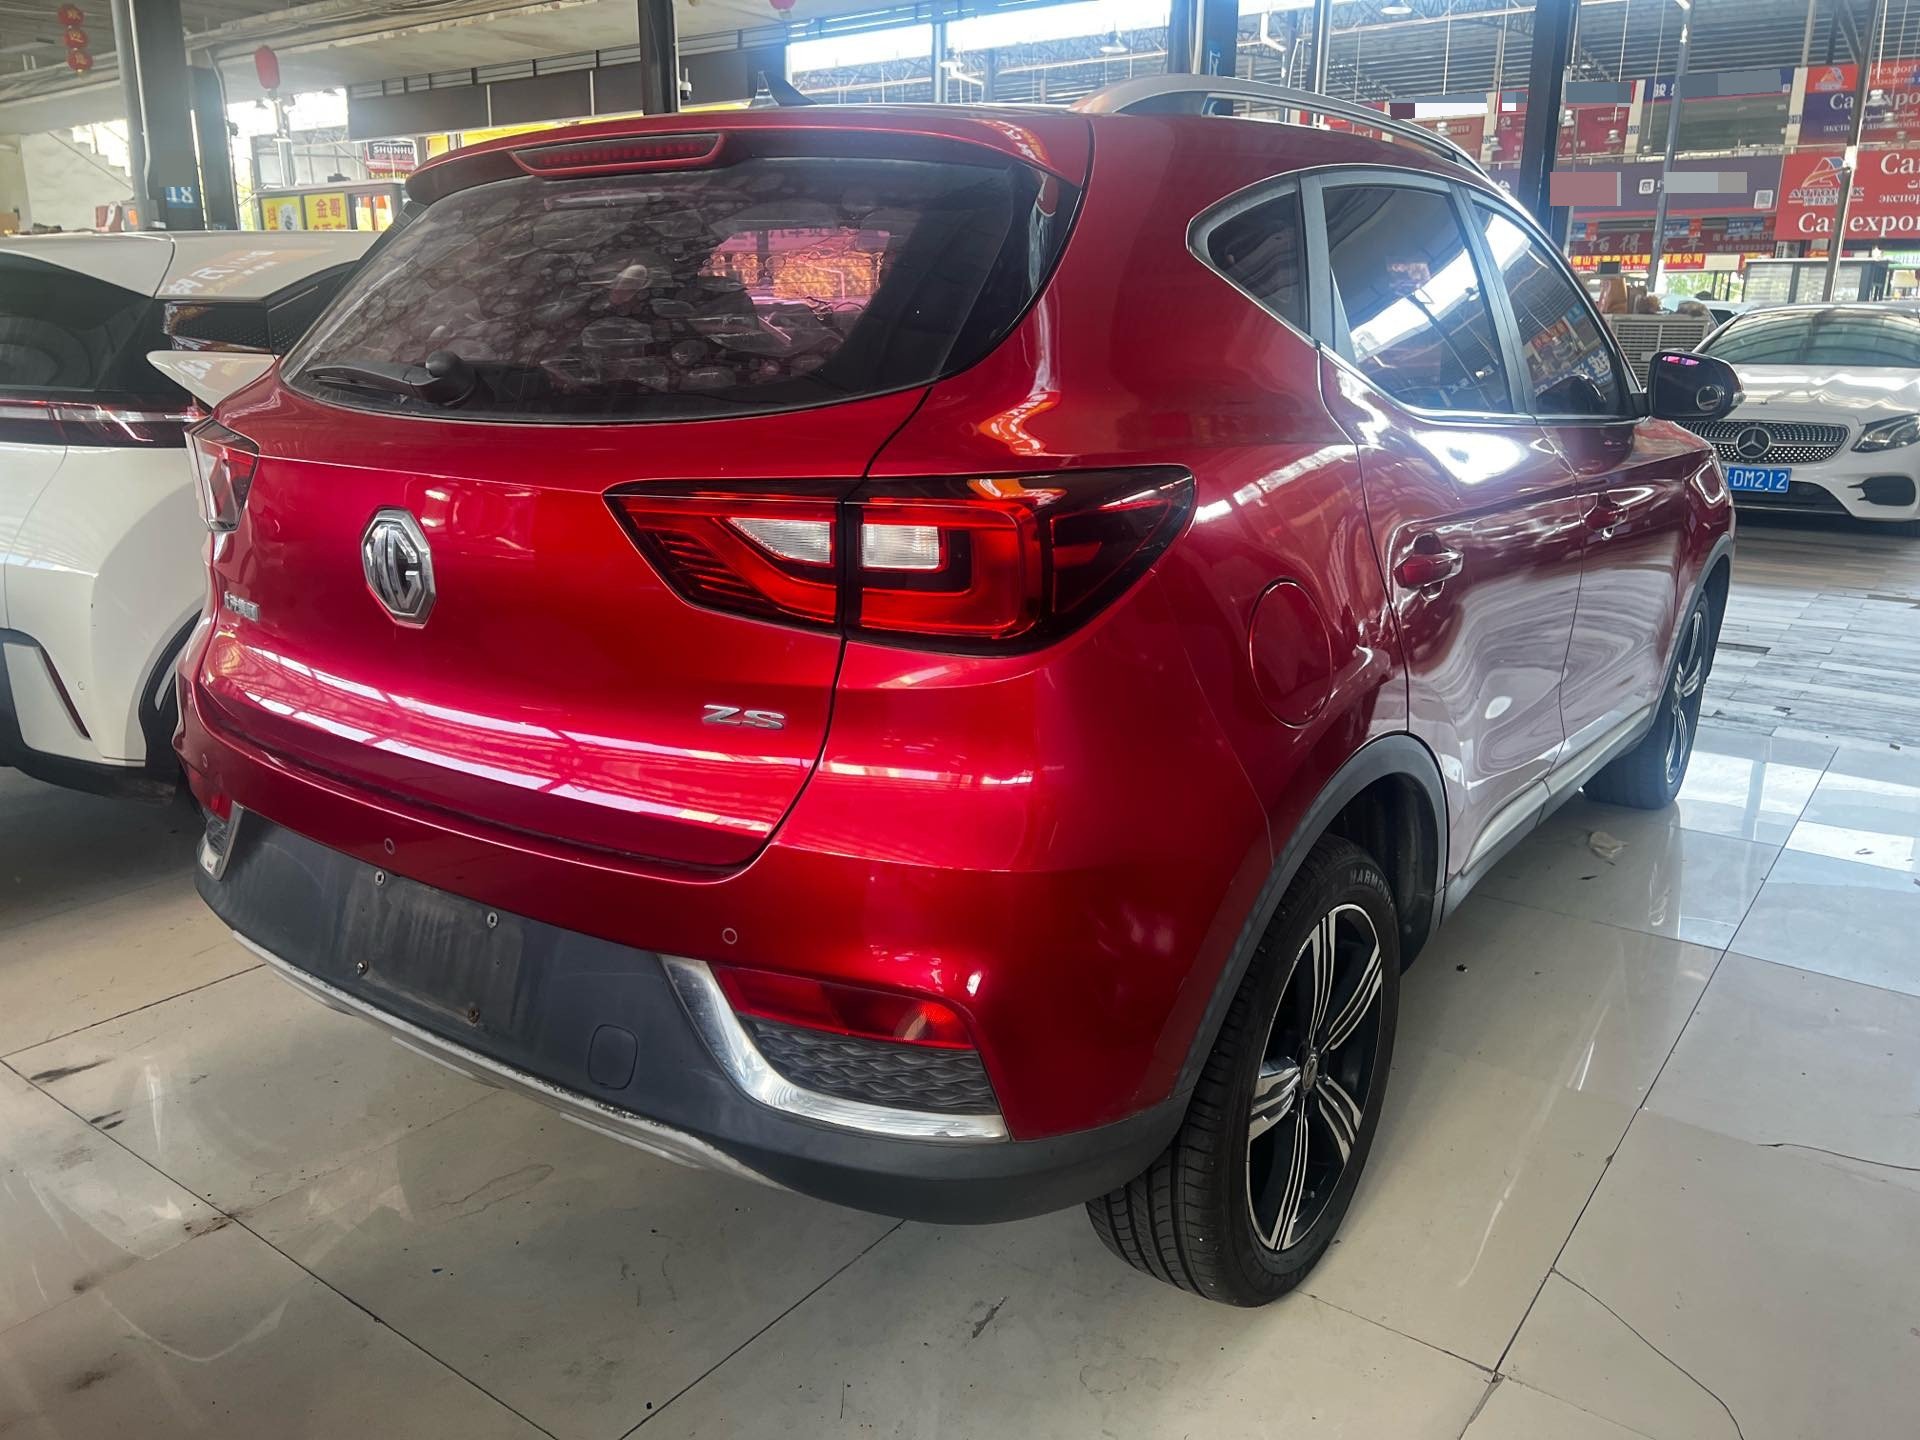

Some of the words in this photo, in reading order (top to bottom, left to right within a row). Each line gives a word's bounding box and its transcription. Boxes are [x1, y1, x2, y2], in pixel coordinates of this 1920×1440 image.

[316, 198, 341, 218] 金哥
[1798, 212, 1837, 233] Ca
[703, 704, 785, 729] ZS
